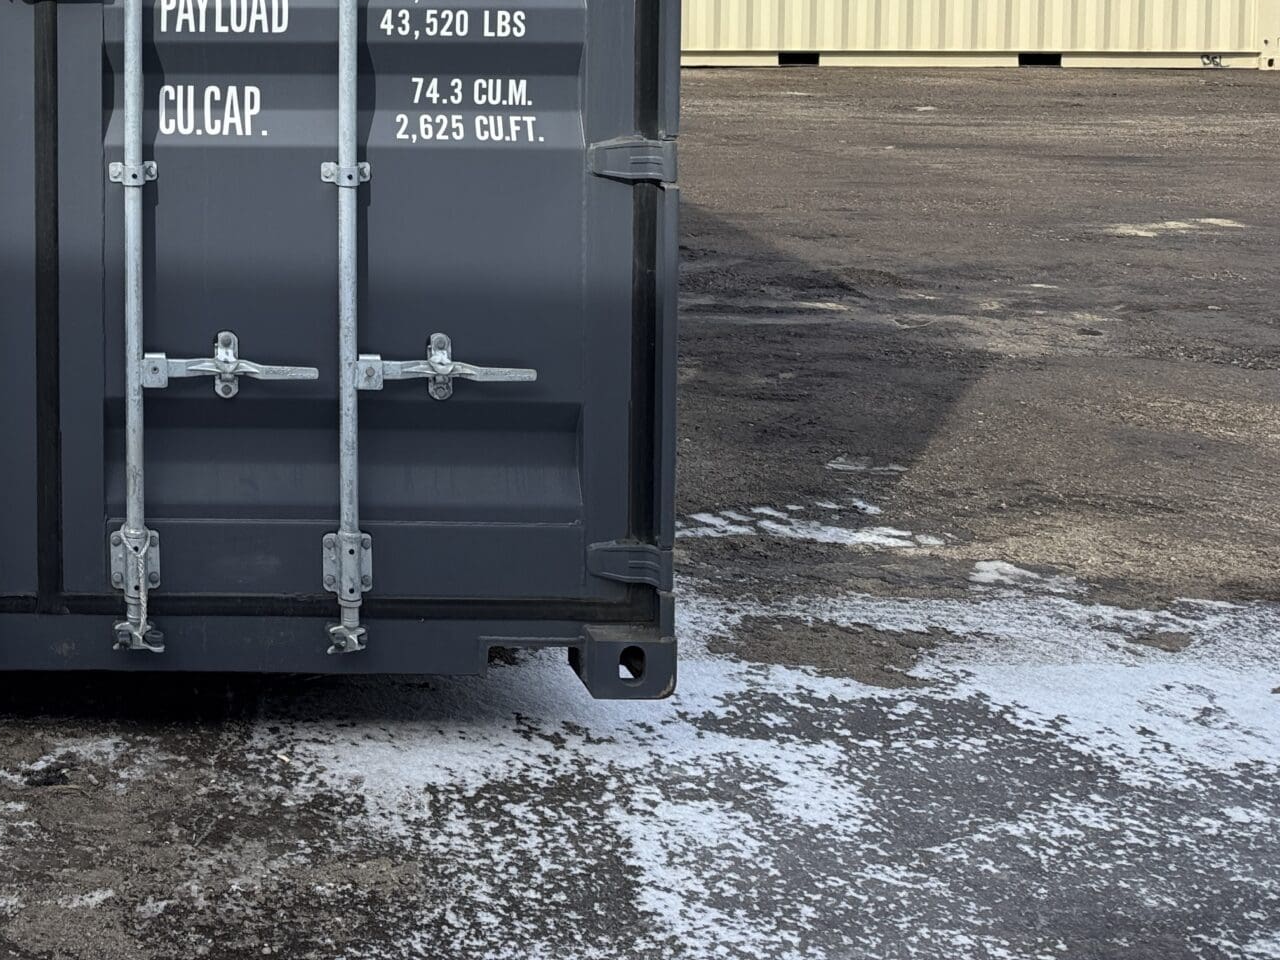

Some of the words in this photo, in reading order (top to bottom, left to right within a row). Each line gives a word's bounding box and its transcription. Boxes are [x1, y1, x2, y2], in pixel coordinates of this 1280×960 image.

[380, 9, 469, 40] 43,520
[483, 10, 526, 38] LBS
[411, 77, 463, 105] 74.3
[473, 78, 533, 106] CU.M.
[159, 85, 268, 136] CU.CAP.
[395, 113, 465, 143] 2,625
[474, 115, 545, 142] CU.FT.
